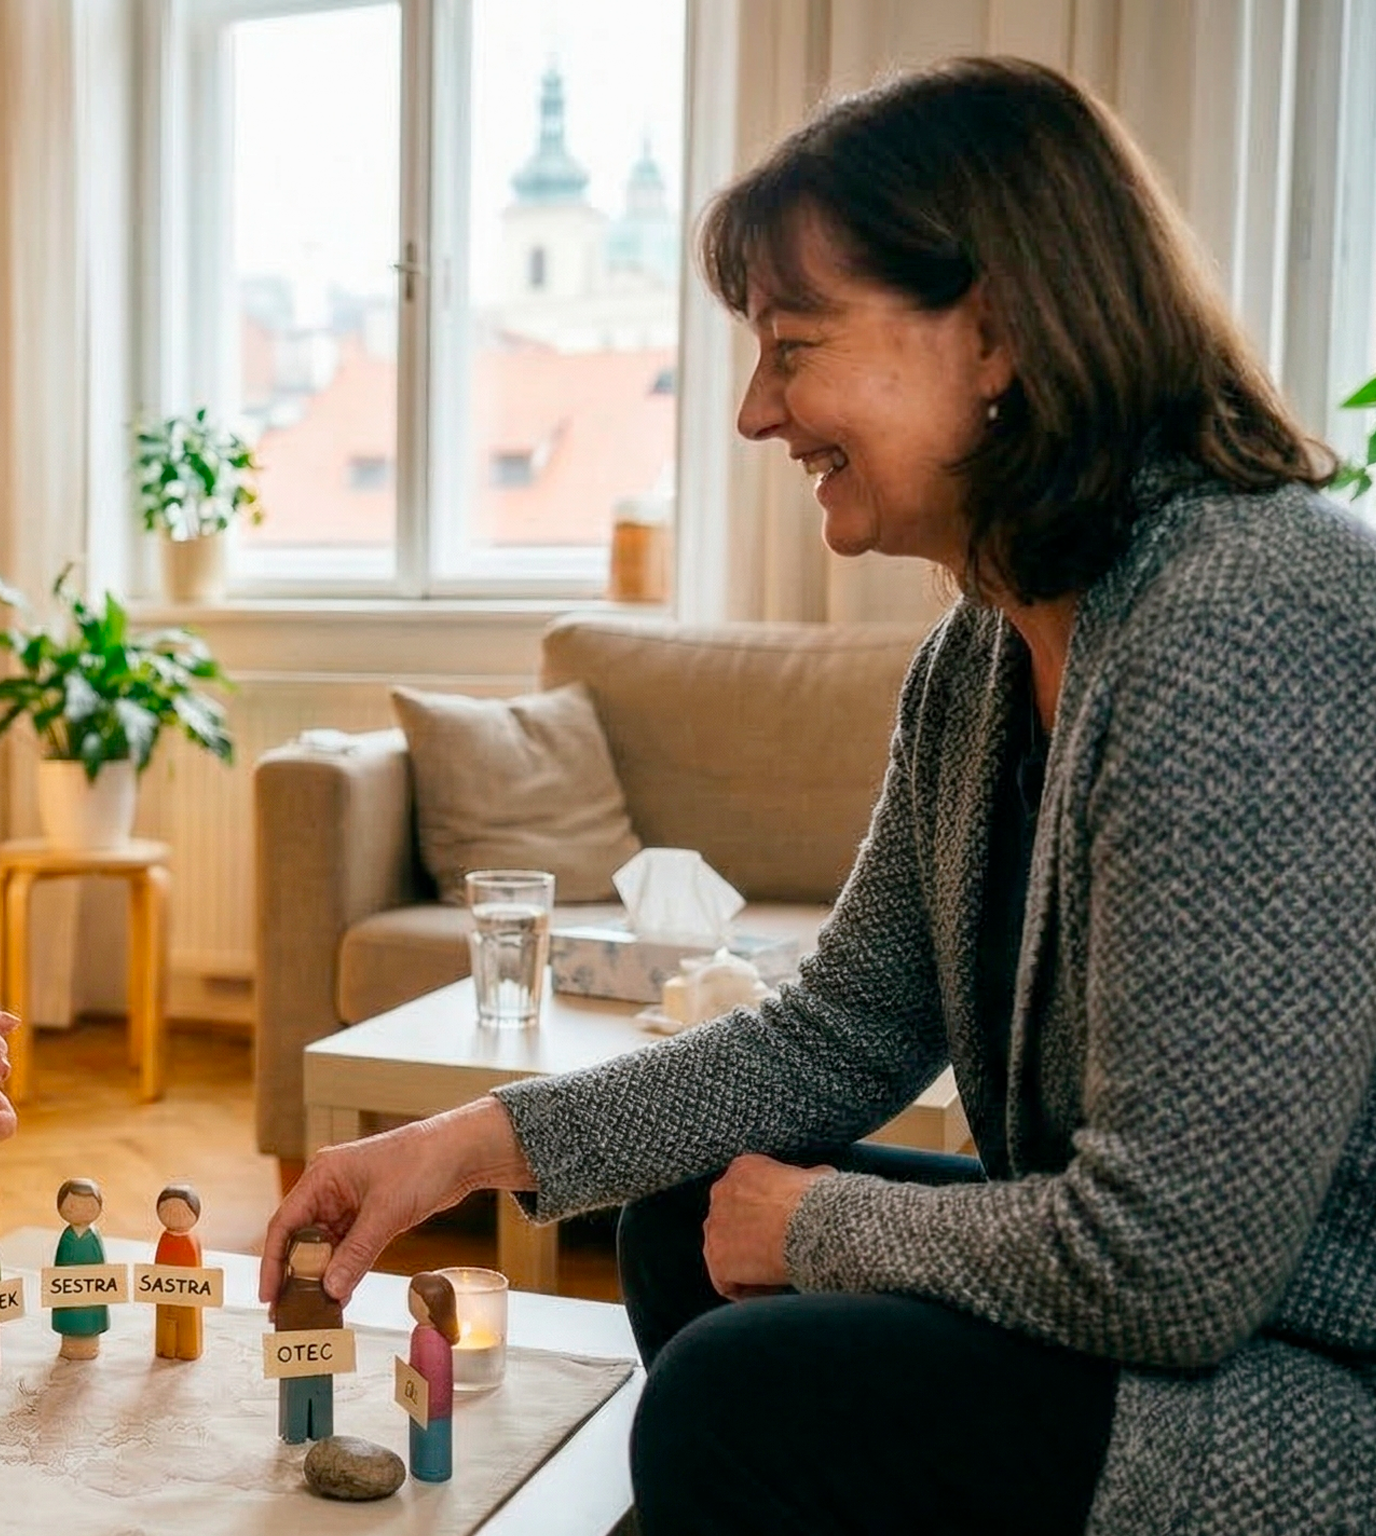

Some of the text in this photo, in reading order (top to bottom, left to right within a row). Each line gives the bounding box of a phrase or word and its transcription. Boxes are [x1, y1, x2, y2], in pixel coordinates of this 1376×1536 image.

[50, 1277, 118, 1294] SESTRA
[138, 1274, 212, 1296] SASTRA
[277, 1342, 333, 1363] OTEC
